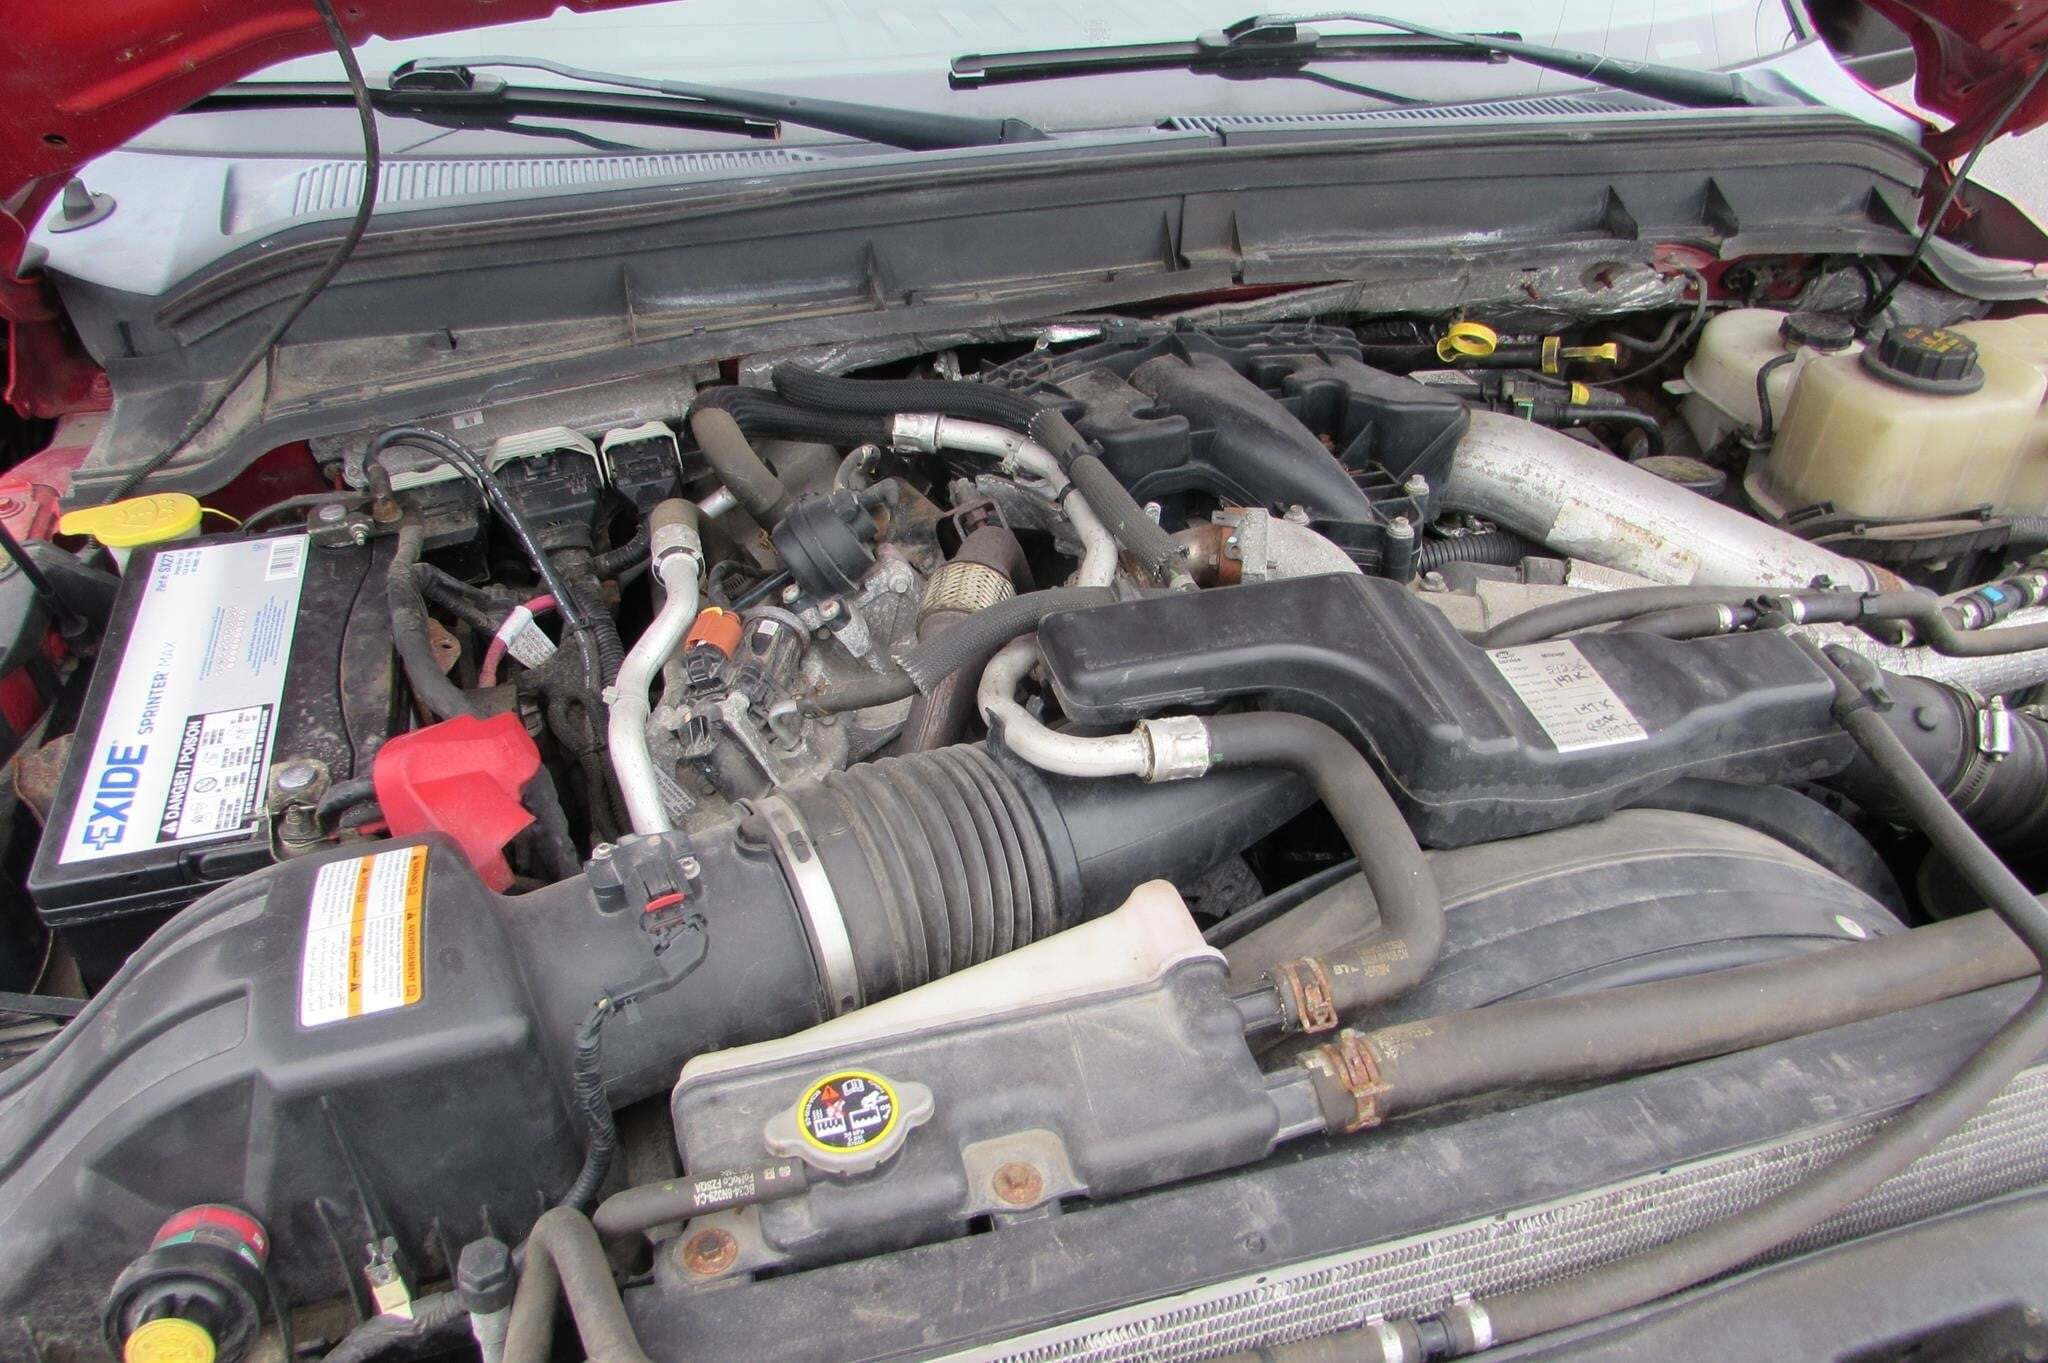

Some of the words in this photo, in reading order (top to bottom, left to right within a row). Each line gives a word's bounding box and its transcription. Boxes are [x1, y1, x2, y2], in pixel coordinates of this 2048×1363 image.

[159, 553, 175, 574] SX27
[137, 672, 169, 735] SPRINTER
[158, 640, 177, 671] MAX
[180, 719, 203, 760] POISON
[82, 744, 149, 850] EXIDE
[169, 767, 194, 820] DANGER
[408, 923, 418, 983] AVERTISSEMENT
[722, 1172, 755, 1187] FoMoCo
